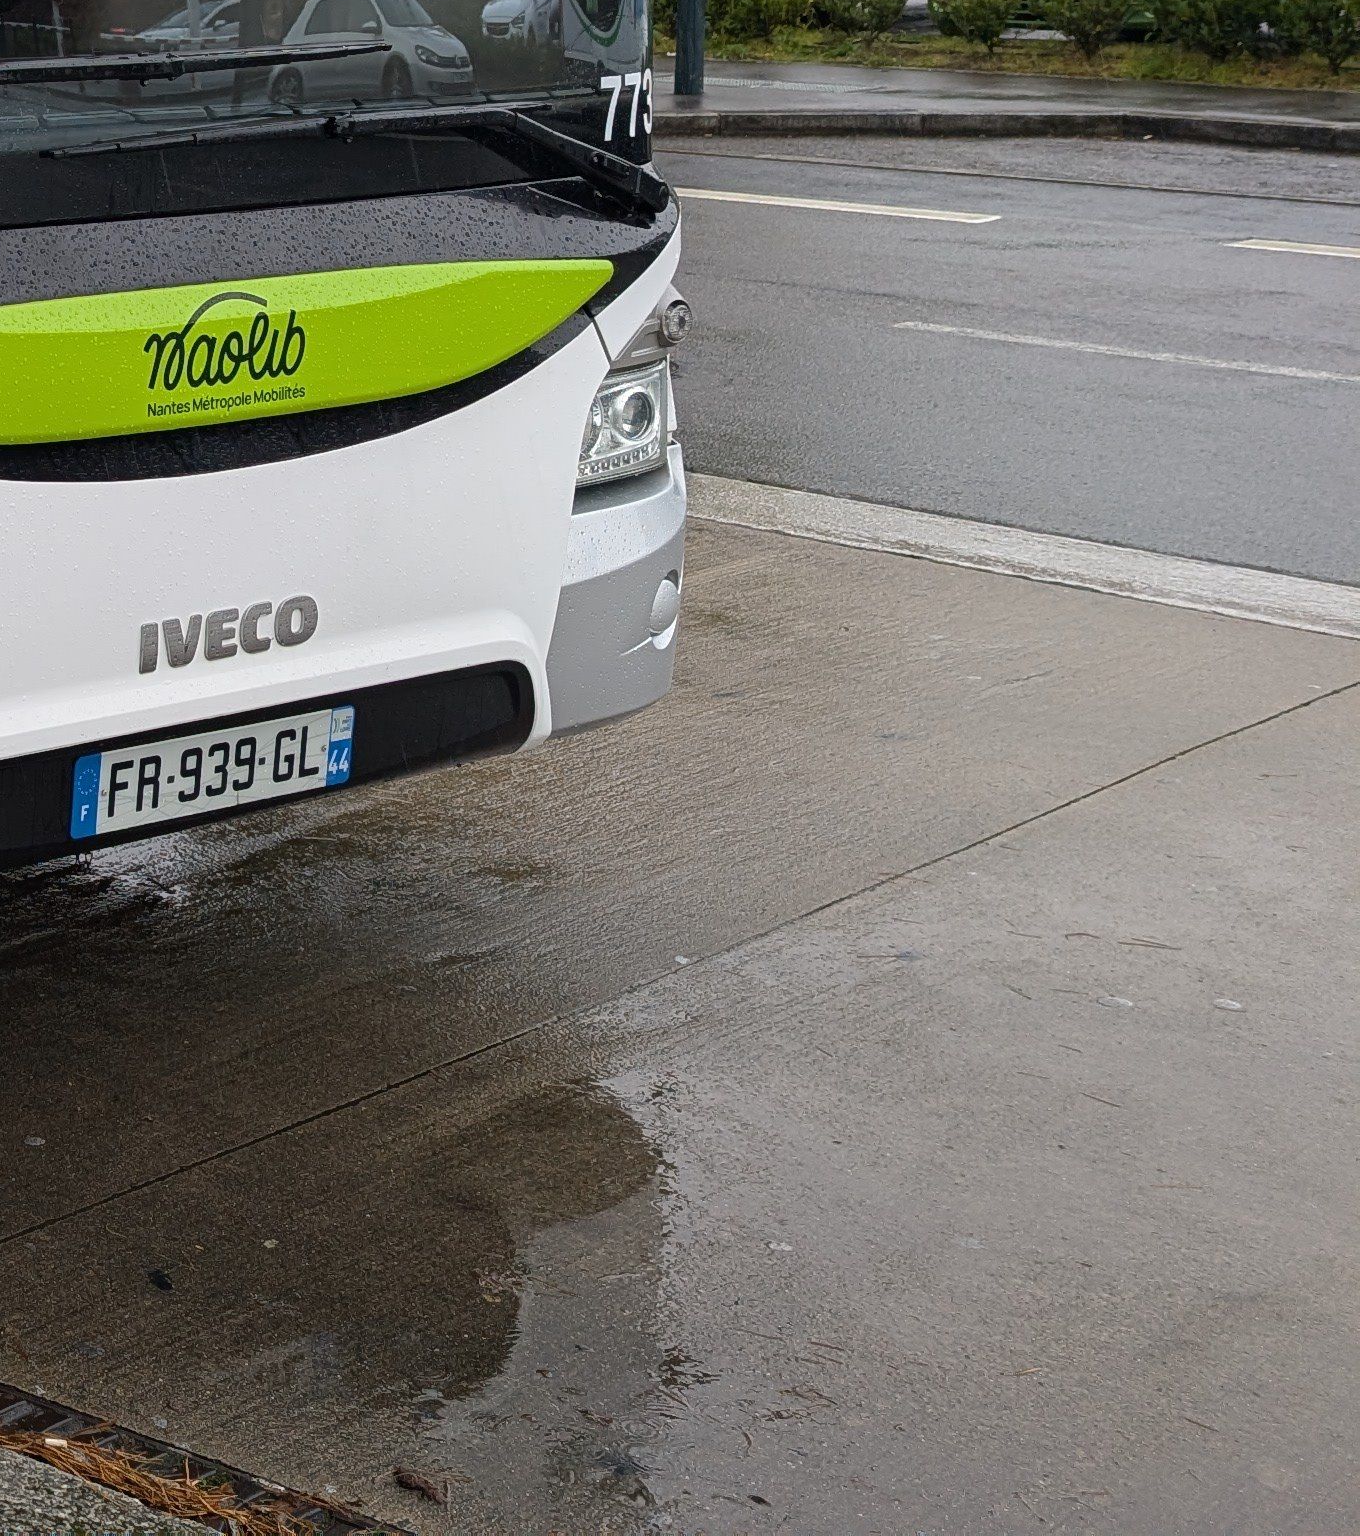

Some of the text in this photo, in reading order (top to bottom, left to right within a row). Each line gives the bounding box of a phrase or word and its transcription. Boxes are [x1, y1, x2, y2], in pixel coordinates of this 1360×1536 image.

[599, 67, 653, 142] 773
[147, 383, 306, 418] Nantes Métropole Mobilités
[138, 594, 319, 675] IVECO
[328, 747, 349, 775] 44
[79, 804, 90, 822] F
